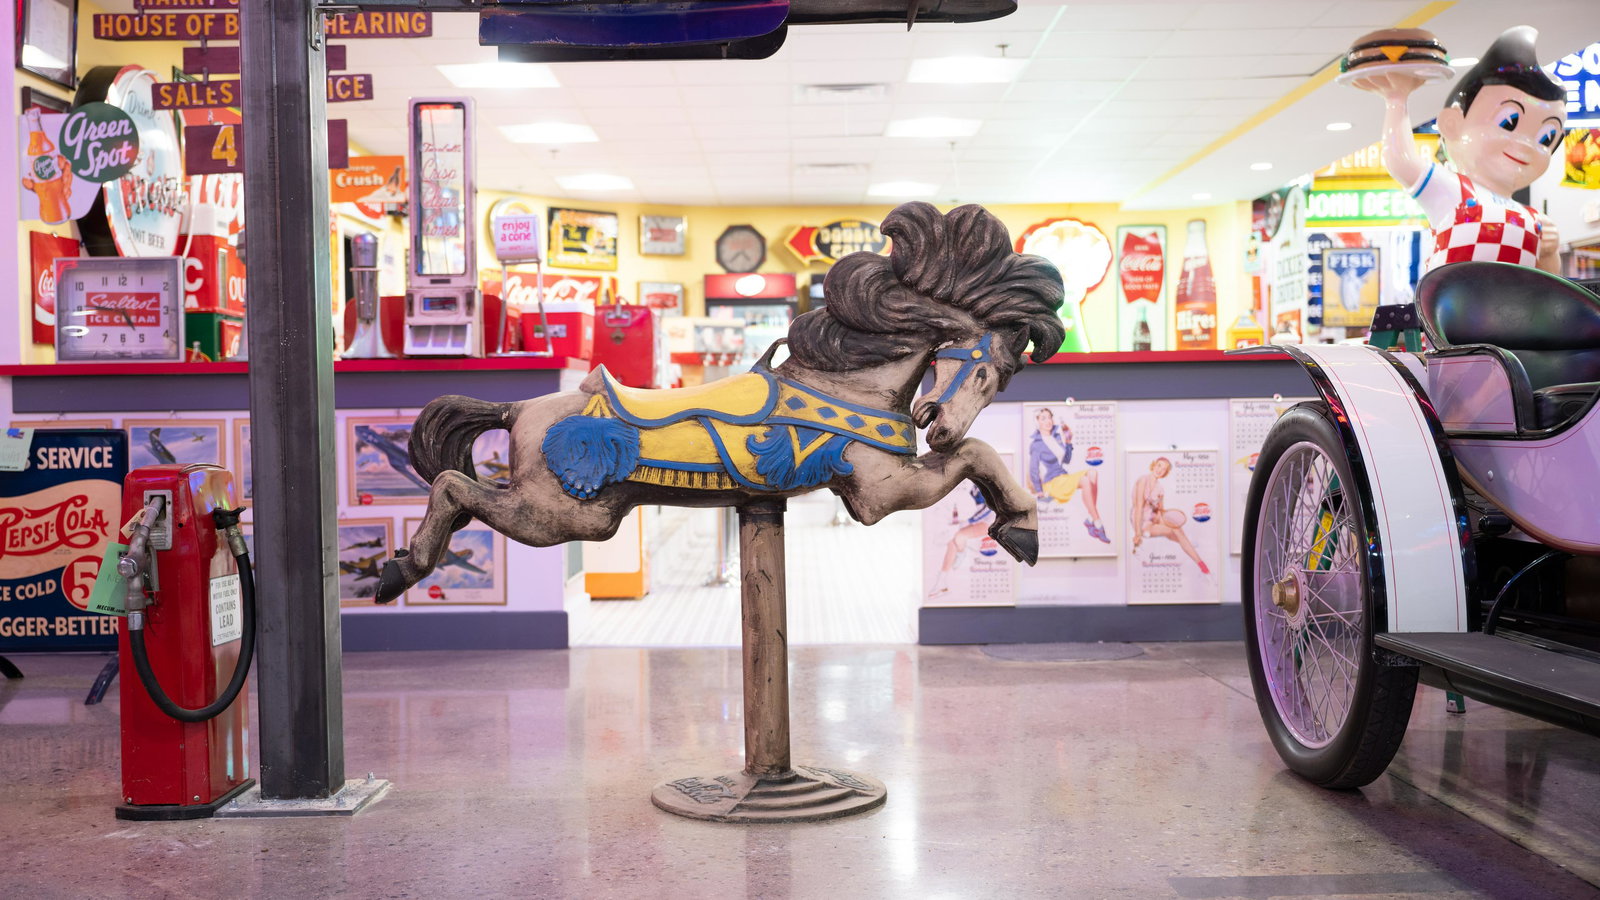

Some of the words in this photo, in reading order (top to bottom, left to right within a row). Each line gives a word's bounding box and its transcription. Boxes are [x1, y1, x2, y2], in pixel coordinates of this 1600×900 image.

[100, 14, 177, 37] HOUSE
[185, 13, 216, 36] OF
[324, 11, 427, 35] HEARING
[159, 82, 234, 107] SALES
[64, 111, 133, 161] Green
[211, 124, 238, 167] 4
[78, 141, 133, 178] Spot
[335, 172, 384, 188] Crush
[1304, 192, 1359, 218] JOHN
[502, 221, 530, 233] enjoy
[501, 233, 507, 242] a
[508, 232, 531, 242] cone
[1329, 253, 1373, 268] FISK
[75, 282, 84, 291] 10
[102, 276, 108, 286] 11
[118, 276, 127, 286] 12
[140, 276, 144, 286] 1
[163, 282, 169, 291] 2
[90, 293, 161, 311] Sealtest
[163, 306, 169, 315] 3
[90, 315, 110, 323] ICE
[1176, 310, 1216, 331] Hires
[102, 333, 108, 343] 7
[120, 333, 126, 343] 6
[139, 333, 145, 343] 5
[163, 329, 169, 338] 4
[36, 446, 113, 470] SERVICE
[15, 579, 57, 600] COLD
[215, 600, 237, 614] CONTAINS
[0, 615, 119, 637] GGER-BETTER
[219, 613, 234, 629] LEAD
